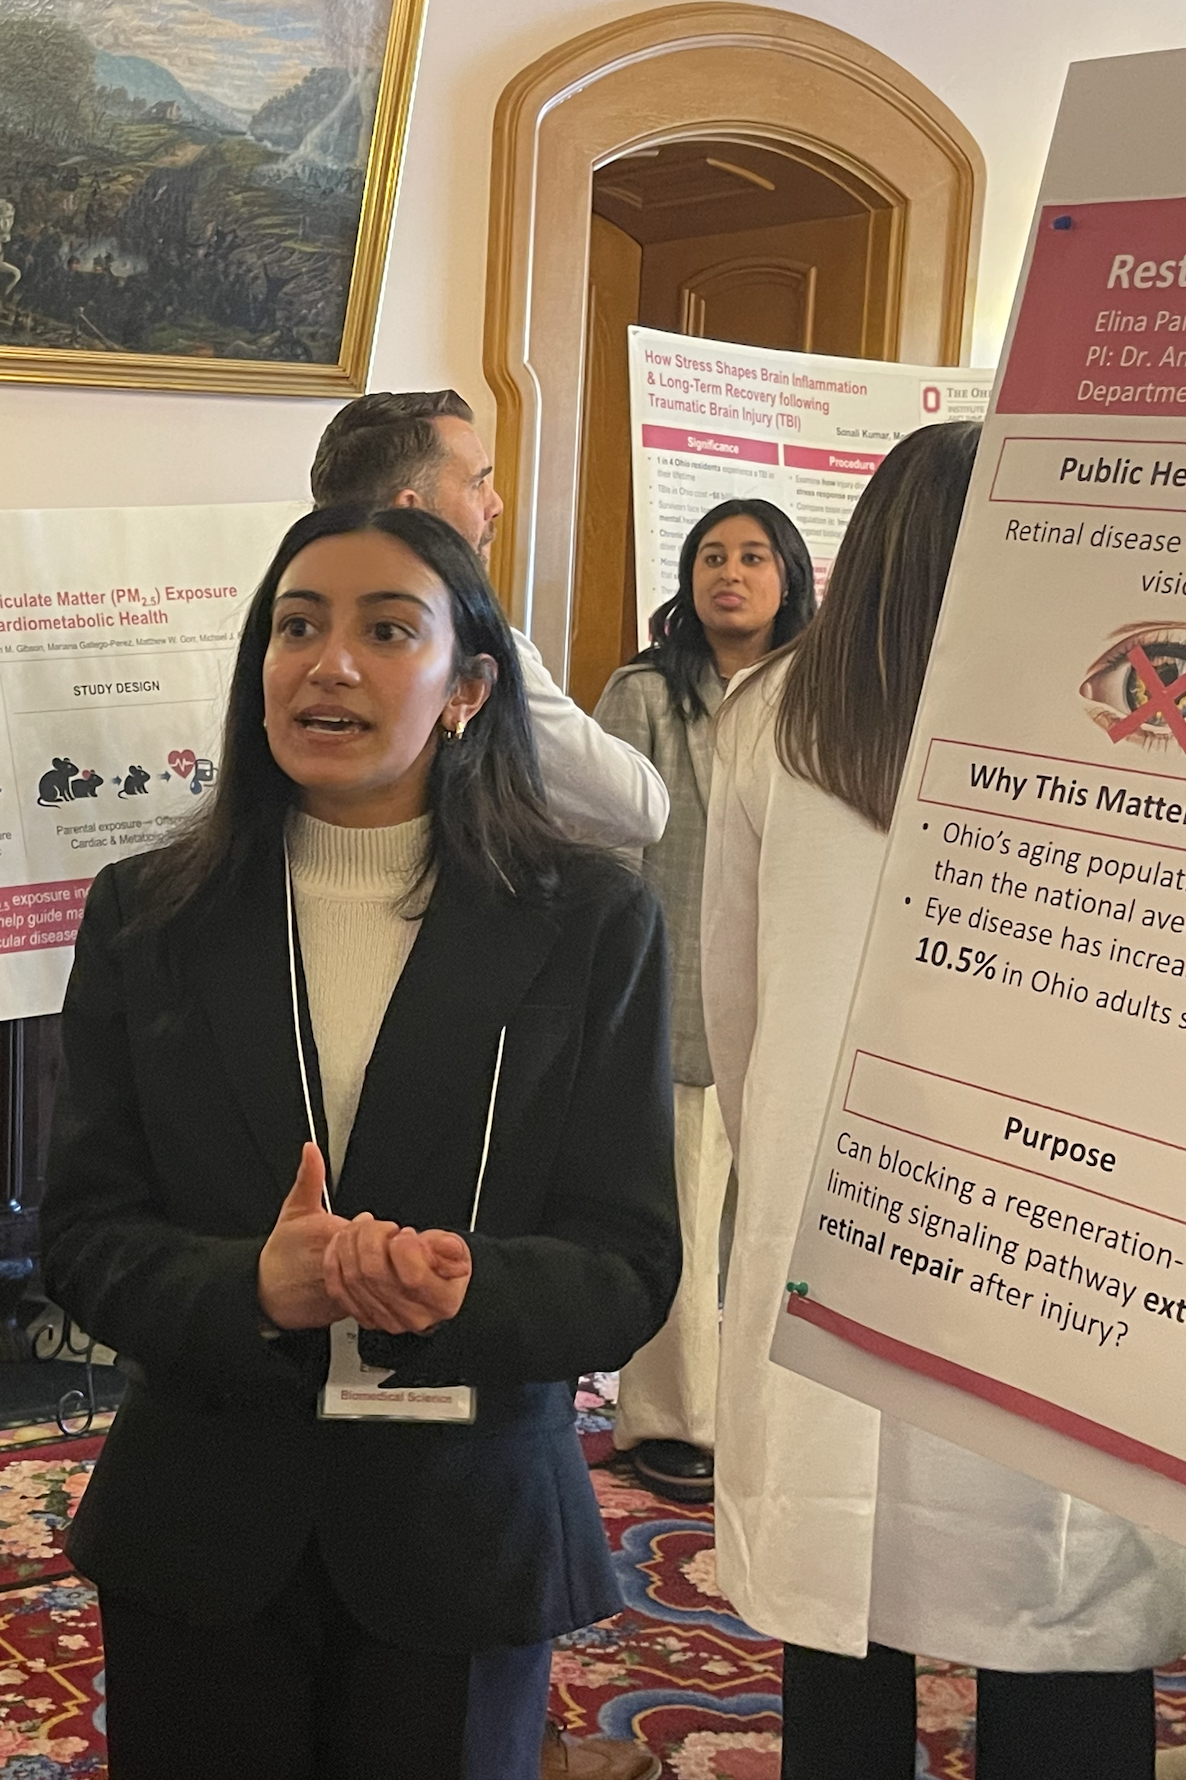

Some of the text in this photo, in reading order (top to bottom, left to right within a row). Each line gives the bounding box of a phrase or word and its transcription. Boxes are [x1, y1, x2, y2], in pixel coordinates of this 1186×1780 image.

[1095, 310, 1186, 333] Elina Pa
[1086, 346, 1113, 367] PI:
[1120, 346, 1152, 367] Dr.
[645, 350, 868, 395] How Stress Shapes Brain Inflammation
[647, 371, 830, 415] & Long-Term Recovery following
[947, 388, 968, 398] THE
[1077, 380, 1186, 406] Departme
[648, 393, 801, 432] Traumatic Brain Injury (TBI)
[836, 427, 860, 437] Sonali
[688, 436, 739, 454] Significance
[675, 459, 690, 468] Ohio
[691, 461, 721, 472] residents
[829, 456, 875, 471] Procedure
[1060, 457, 1186, 488] Public He
[1005, 519, 1181, 553] Retinal disease
[57, 591, 106, 606] Matter
[165, 586, 237, 602] Exposure
[118, 610, 169, 626] Health
[73, 680, 160, 697] STUDY DESIGN
[970, 763, 1186, 825] Why This Matte
[56, 823, 96, 835] Parental
[71, 838, 107, 849] Cardiac
[110, 836, 117, 845] &
[943, 822, 1186, 891] Ohio’s aging populat
[13, 889, 70, 907] exposure
[934, 860, 1186, 934] than the national ave
[27, 908, 62, 928] guide
[30, 929, 77, 945] disease
[925, 897, 1186, 977] Eye disease has increa
[915, 937, 998, 980] 10.5%
[1002, 961, 1023, 987] in
[1031, 970, 1089, 1004] Ohio
[1096, 990, 1172, 1025] adults
[1004, 1116, 1116, 1173] Purpose
[837, 1132, 1184, 1270] Can blocking a regeneration-
[827, 1168, 904, 1224] limiting
[908, 1205, 1019, 1265] signaling
[1024, 1247, 1137, 1308] pathway
[819, 1214, 1129, 1347] retinal repair after injury?
[341, 1390, 404, 1402] Biomedical
